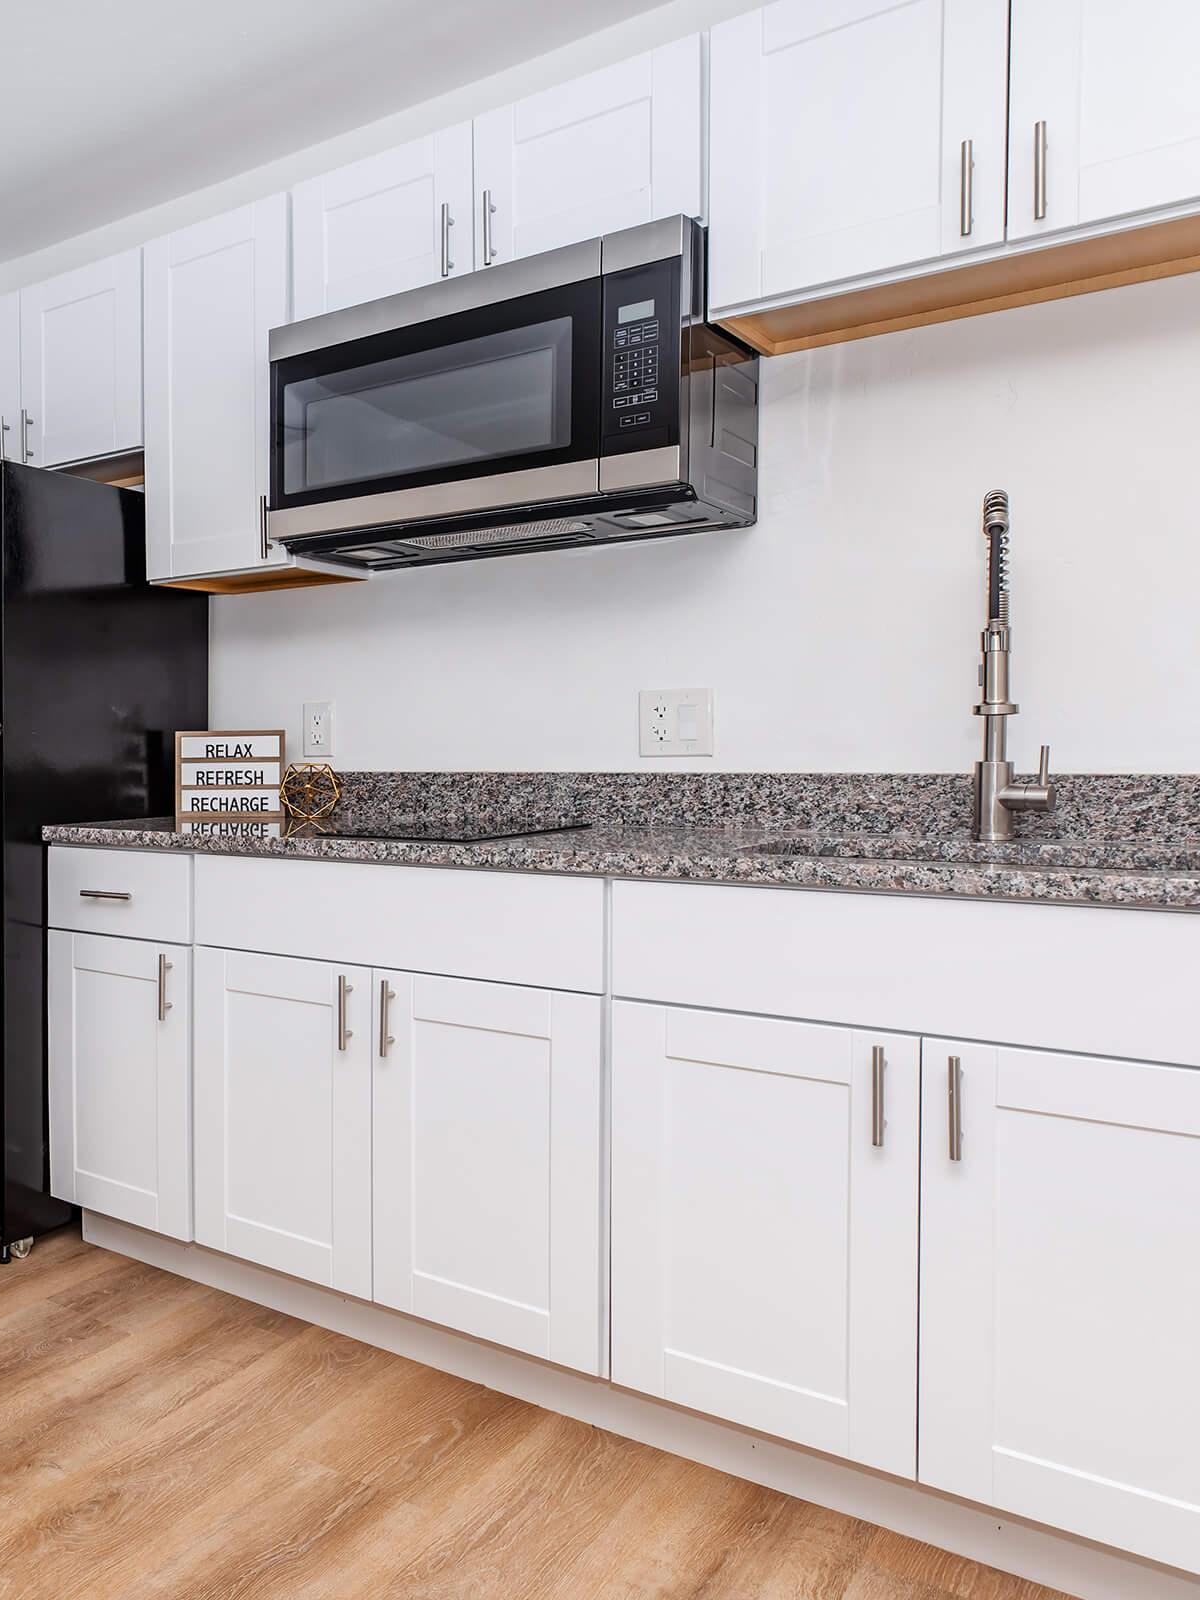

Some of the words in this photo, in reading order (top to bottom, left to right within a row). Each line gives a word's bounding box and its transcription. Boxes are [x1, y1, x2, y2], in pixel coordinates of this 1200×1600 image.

[205, 744, 253, 758] RELAX
[196, 770, 264, 785] REFRESH
[191, 797, 269, 812] RECHARGE
